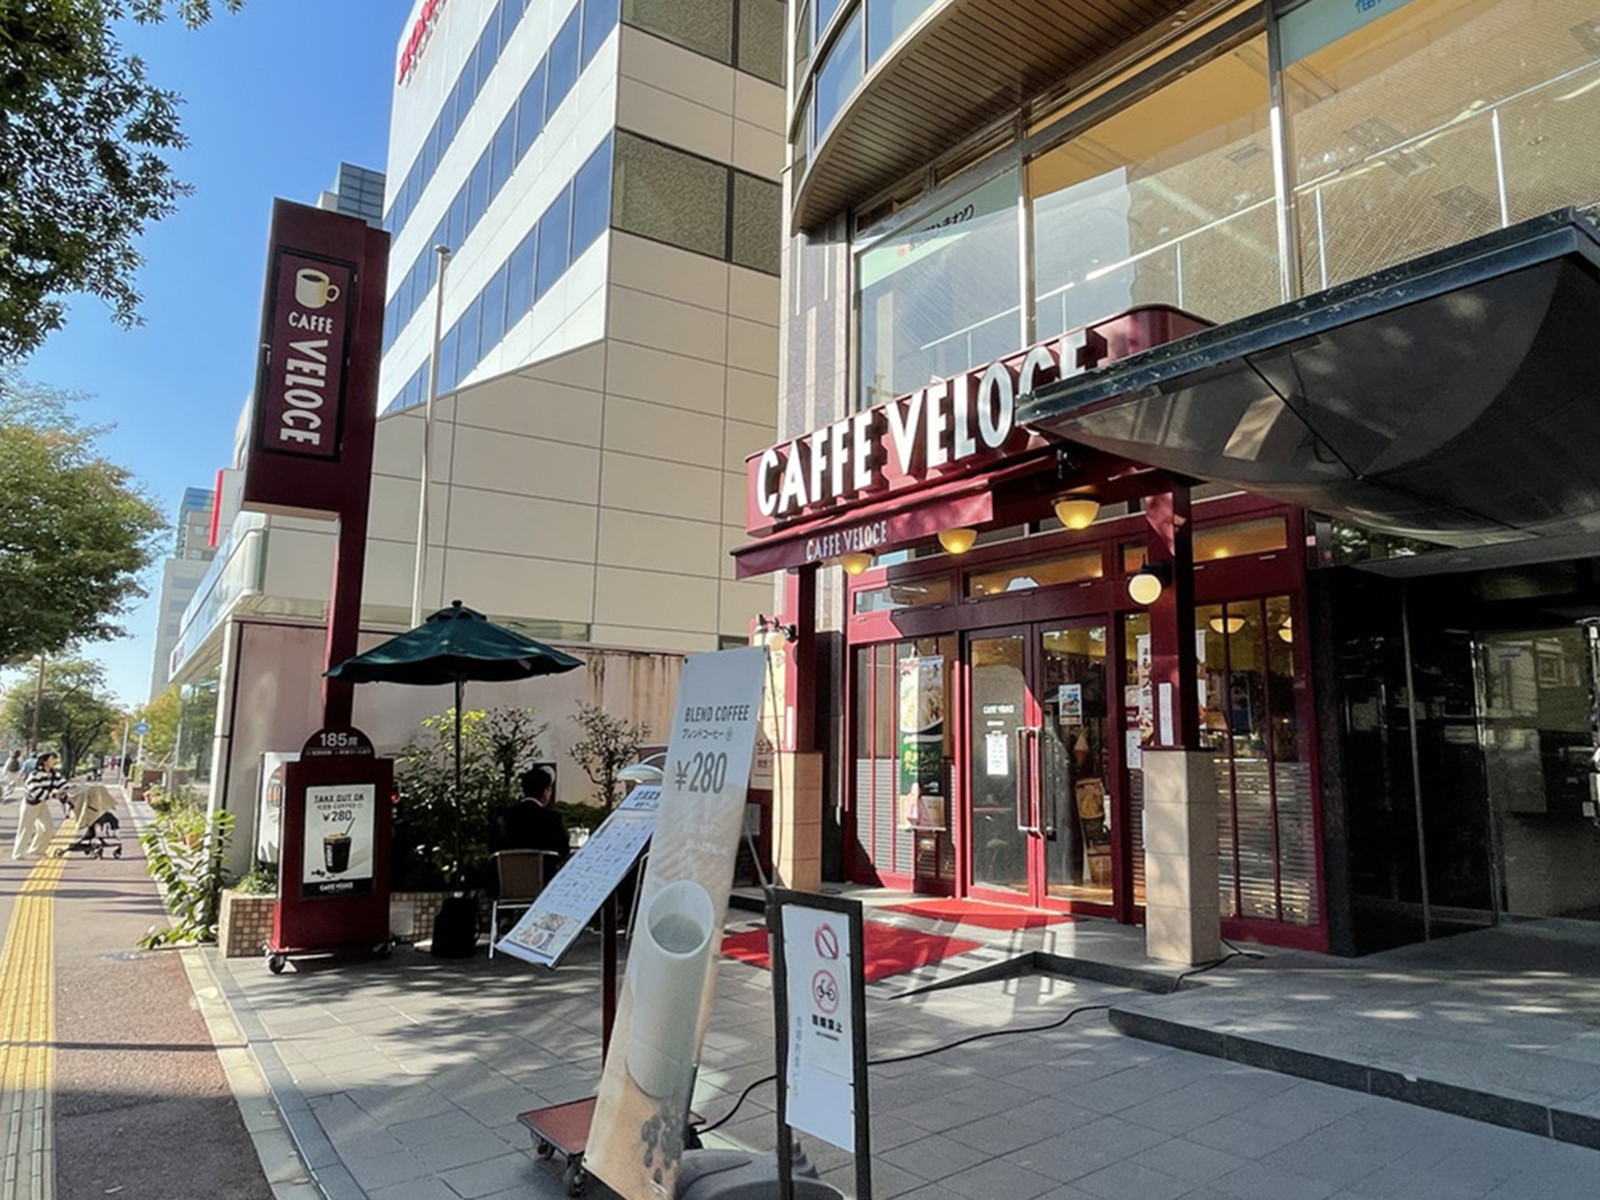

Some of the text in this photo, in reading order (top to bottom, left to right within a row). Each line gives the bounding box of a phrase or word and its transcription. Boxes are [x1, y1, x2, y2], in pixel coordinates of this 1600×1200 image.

[288, 311, 333, 334] CAFFE
[280, 339, 328, 446] VELOCE
[757, 411, 872, 516] CAFFE
[806, 520, 887, 561] CAFFE VELOCE
[685, 704, 750, 722] BLEND COFFEE
[675, 751, 727, 794] ¥280
